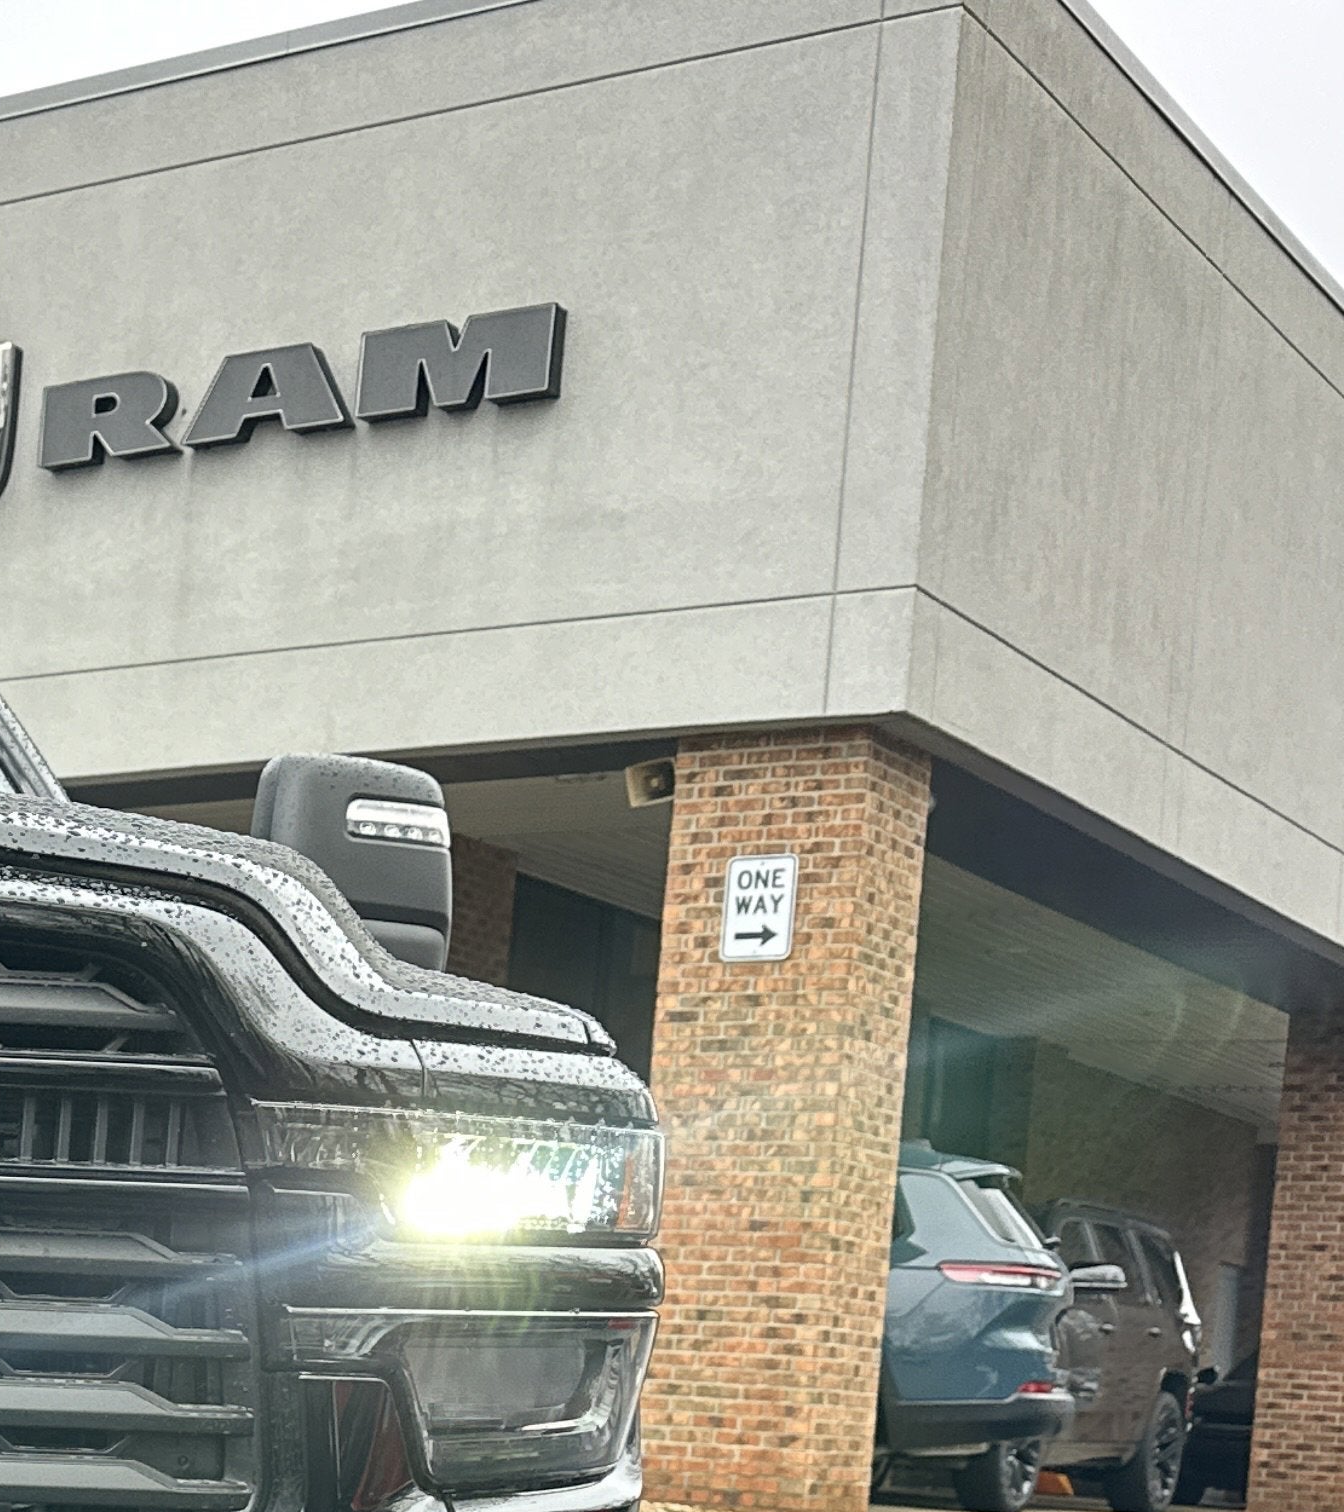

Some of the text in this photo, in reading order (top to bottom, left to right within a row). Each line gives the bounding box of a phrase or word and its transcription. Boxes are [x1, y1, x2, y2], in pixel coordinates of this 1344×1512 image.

[38, 303, 566, 470] RAM
[737, 868, 786, 890] ONE
[735, 894, 784, 915] WAY
